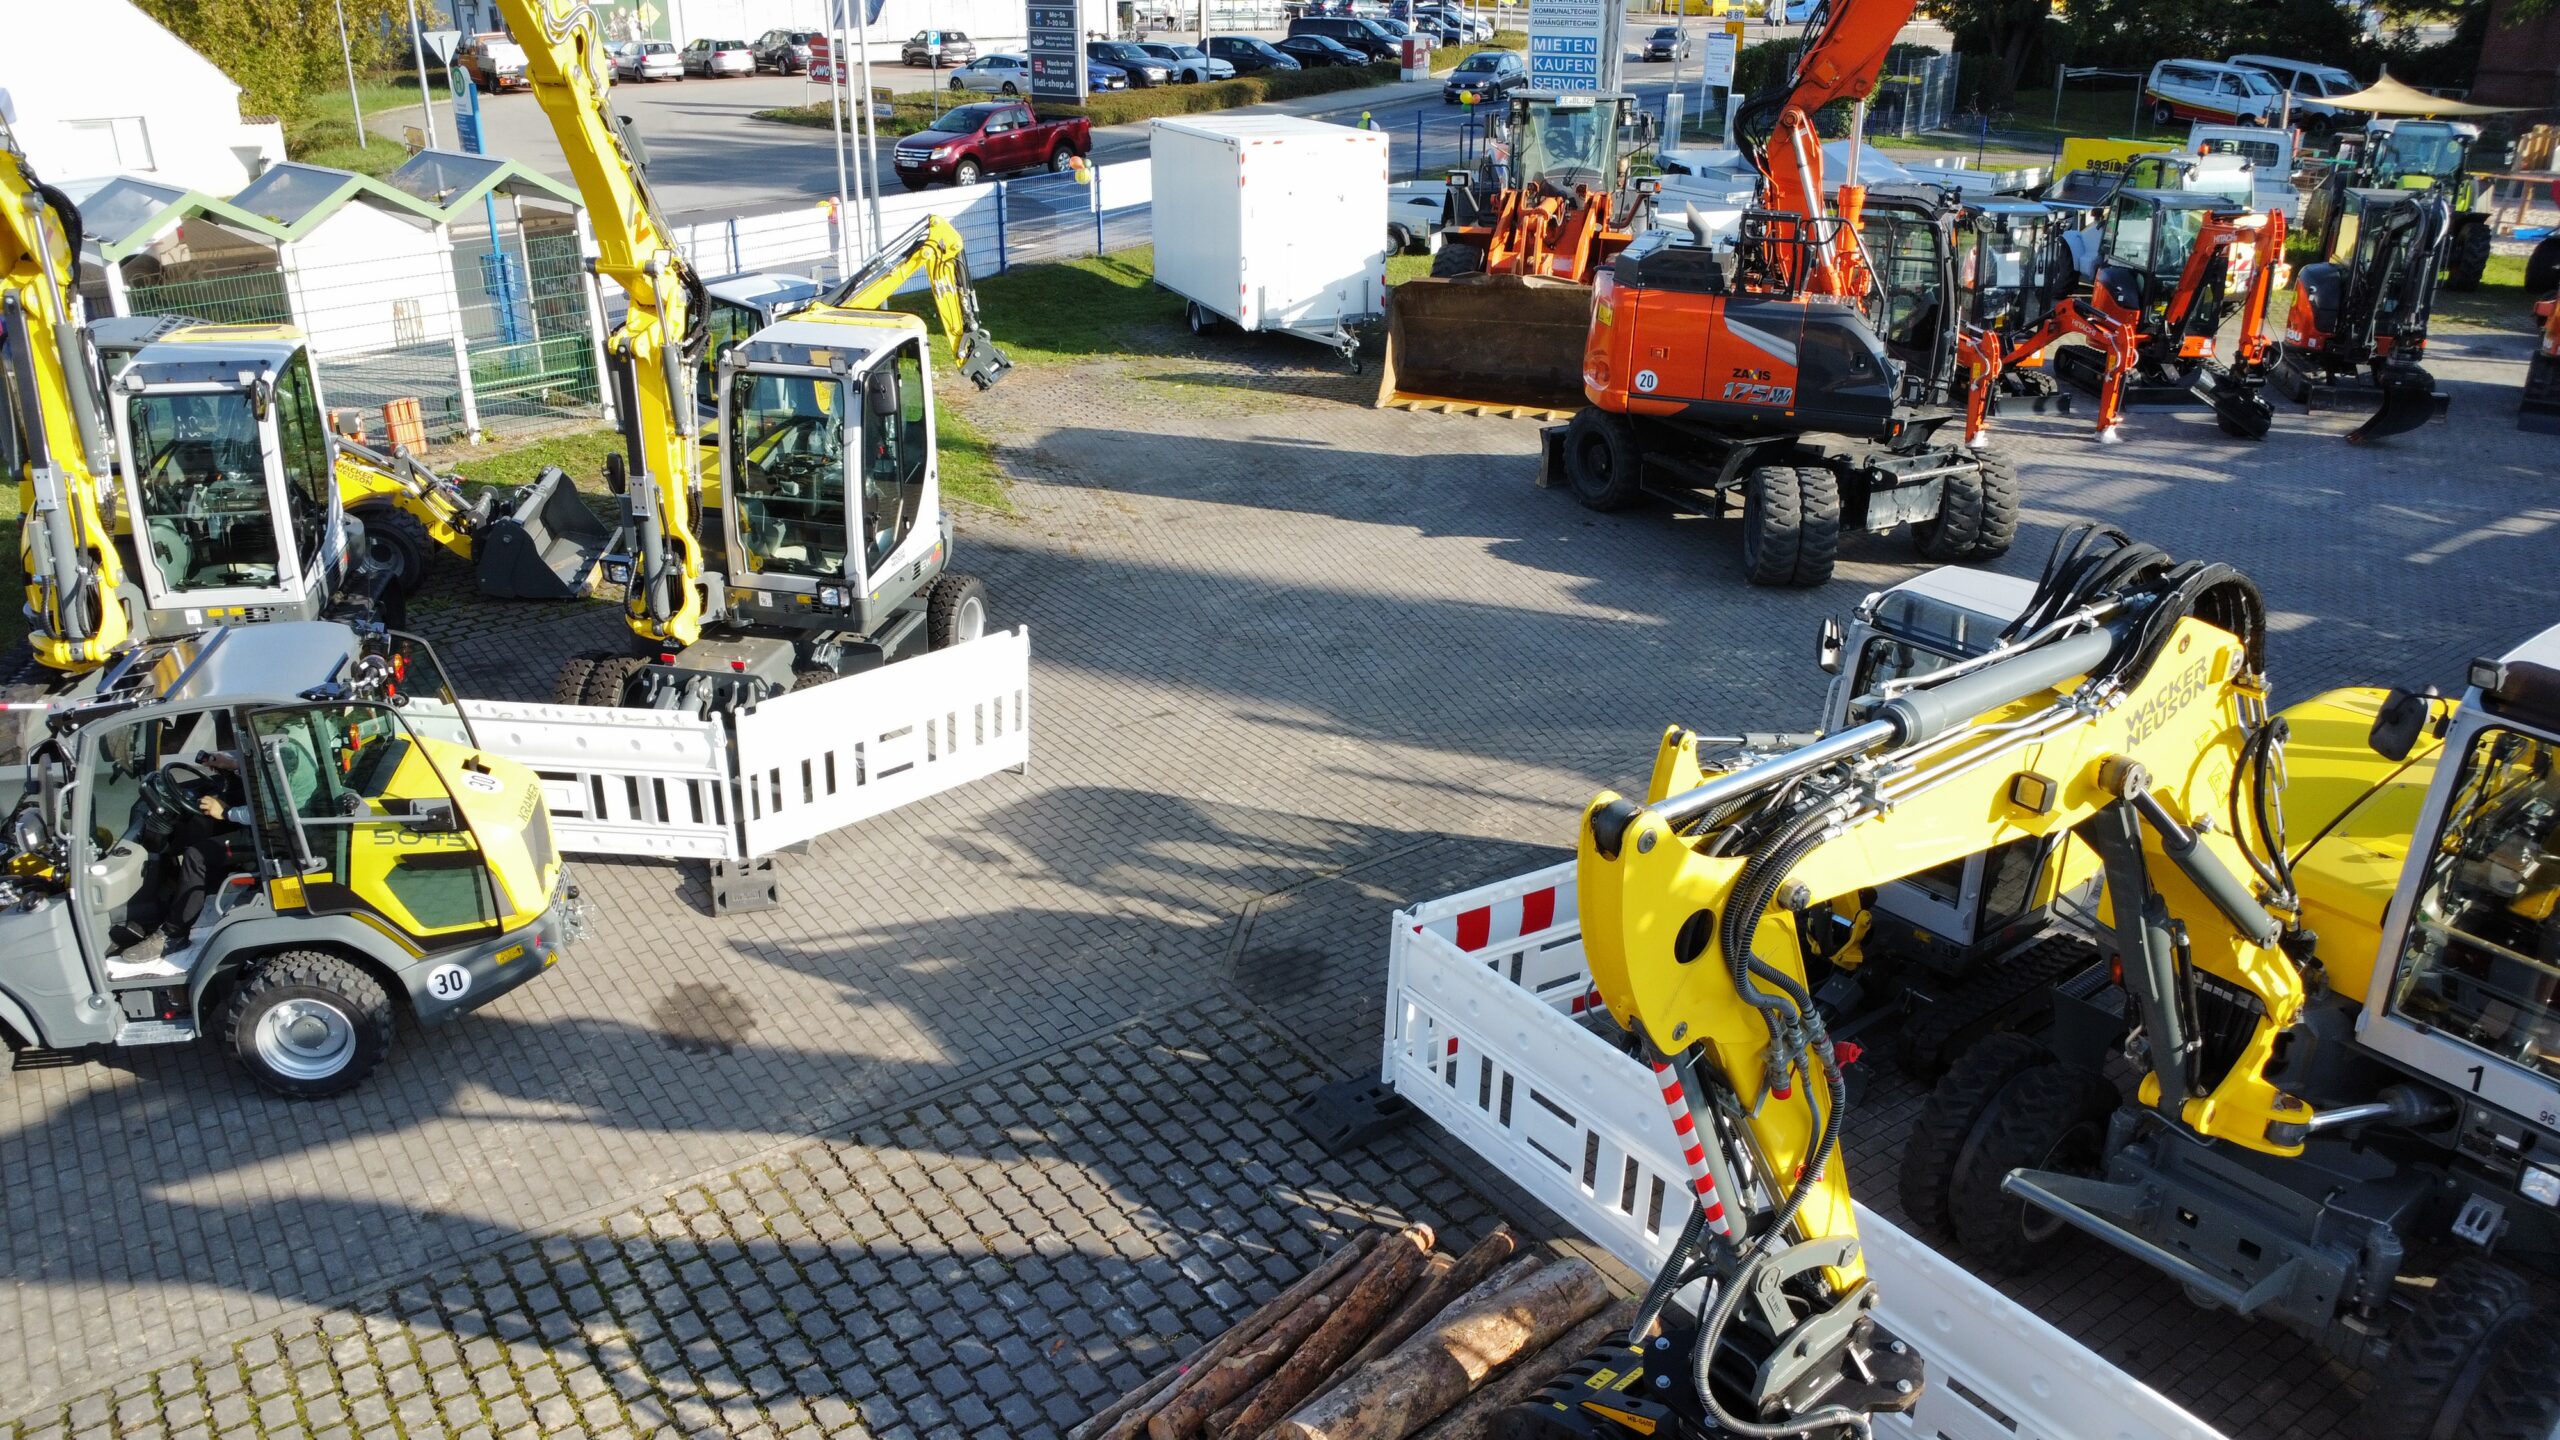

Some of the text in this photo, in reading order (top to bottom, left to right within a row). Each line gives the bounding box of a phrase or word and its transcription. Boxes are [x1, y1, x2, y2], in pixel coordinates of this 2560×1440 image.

[1534, 7, 1598, 15] KOMMUNALTECHNIK
[1734, 11, 1744, 20] 87
[1533, 18, 1598, 27] ANHÄNGERTECHNIK
[1533, 38, 1595, 53] MIETEN
[1533, 57, 1595, 73] KAUFEN
[1034, 78, 1075, 90] lidl-shop.de
[1533, 76, 1595, 90] SERVICE
[1639, 373, 1654, 388] 20
[1733, 367, 1772, 381] ZAXIS
[1722, 381, 1794, 404] 175W
[2125, 655, 2207, 732] WACKER
[2126, 673, 2207, 754] NEUSON
[468, 774, 496, 792] 30
[518, 783, 539, 823] KRAMER
[373, 828, 468, 848] 5045
[434, 969, 464, 996] 30
[2467, 1065, 2485, 1094] 1
[2540, 1110, 2557, 1126] 96
